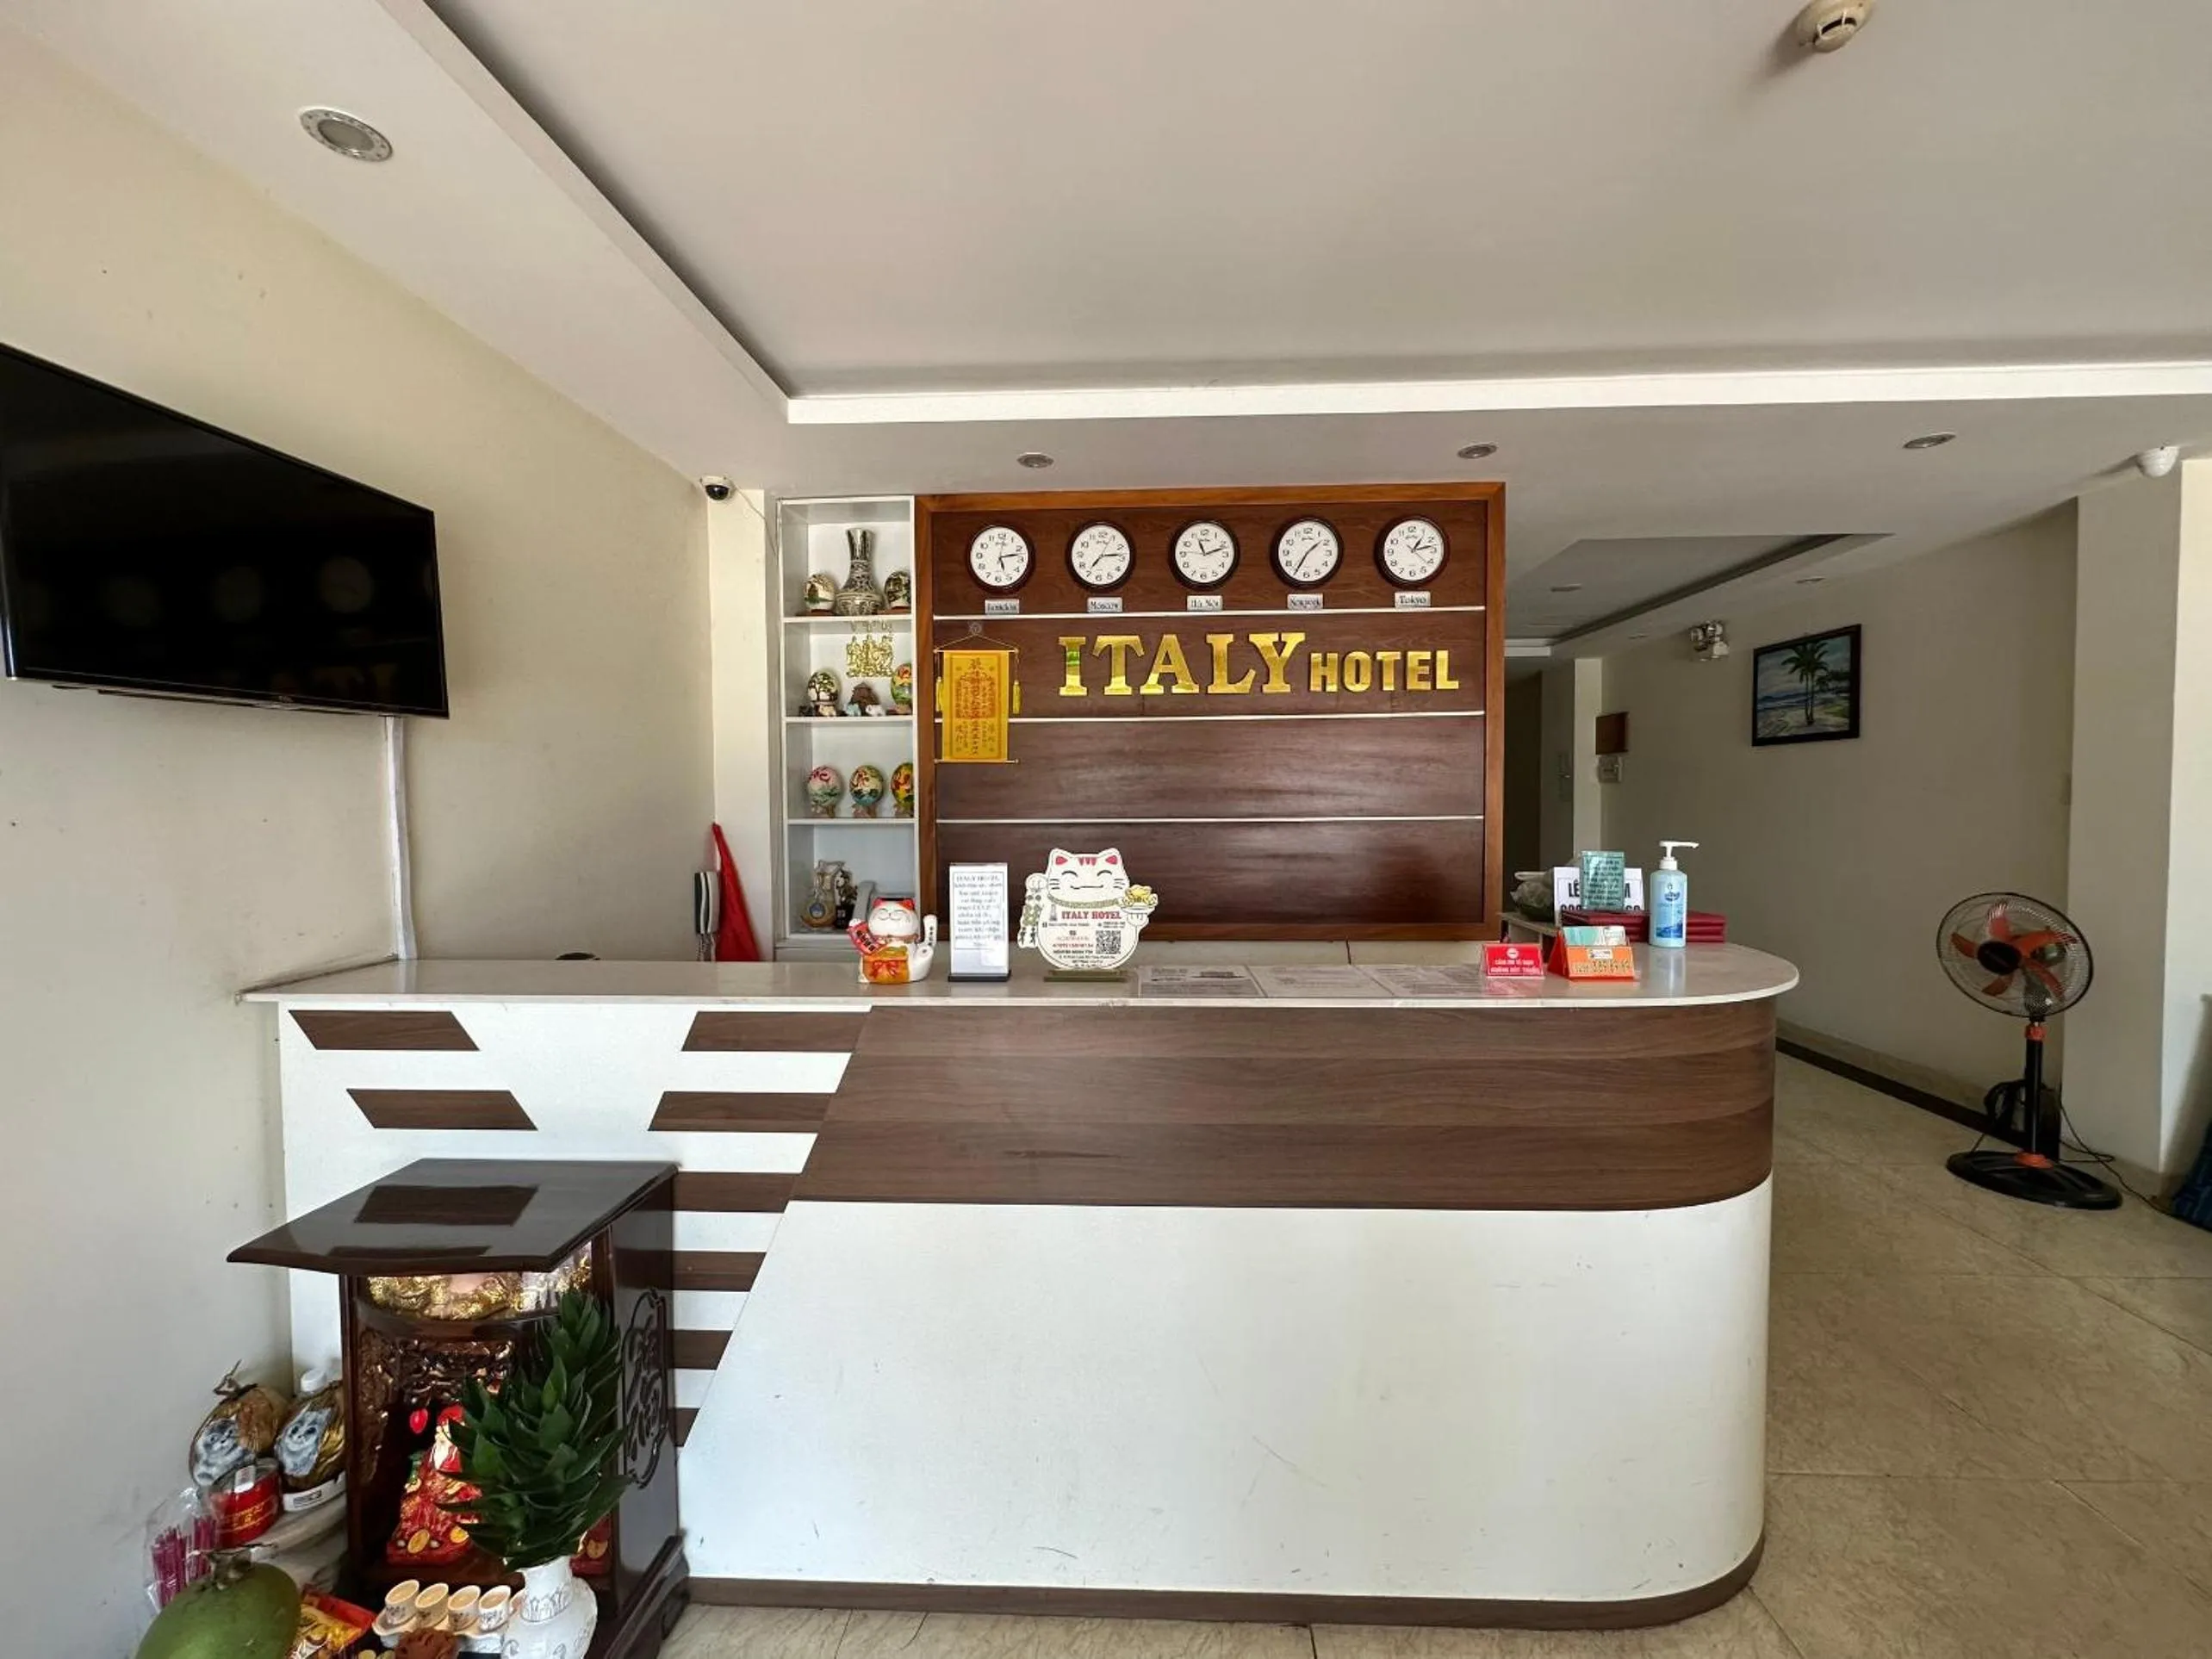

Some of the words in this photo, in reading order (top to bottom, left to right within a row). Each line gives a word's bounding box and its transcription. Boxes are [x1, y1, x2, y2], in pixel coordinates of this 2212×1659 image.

[1400, 595, 1427, 606] Tokyo
[1059, 632, 1305, 695] ITALY
[1310, 649, 1459, 693] HOTEL
[1061, 911, 1090, 920] ITALY
[1092, 911, 1122, 920] HOTEL
